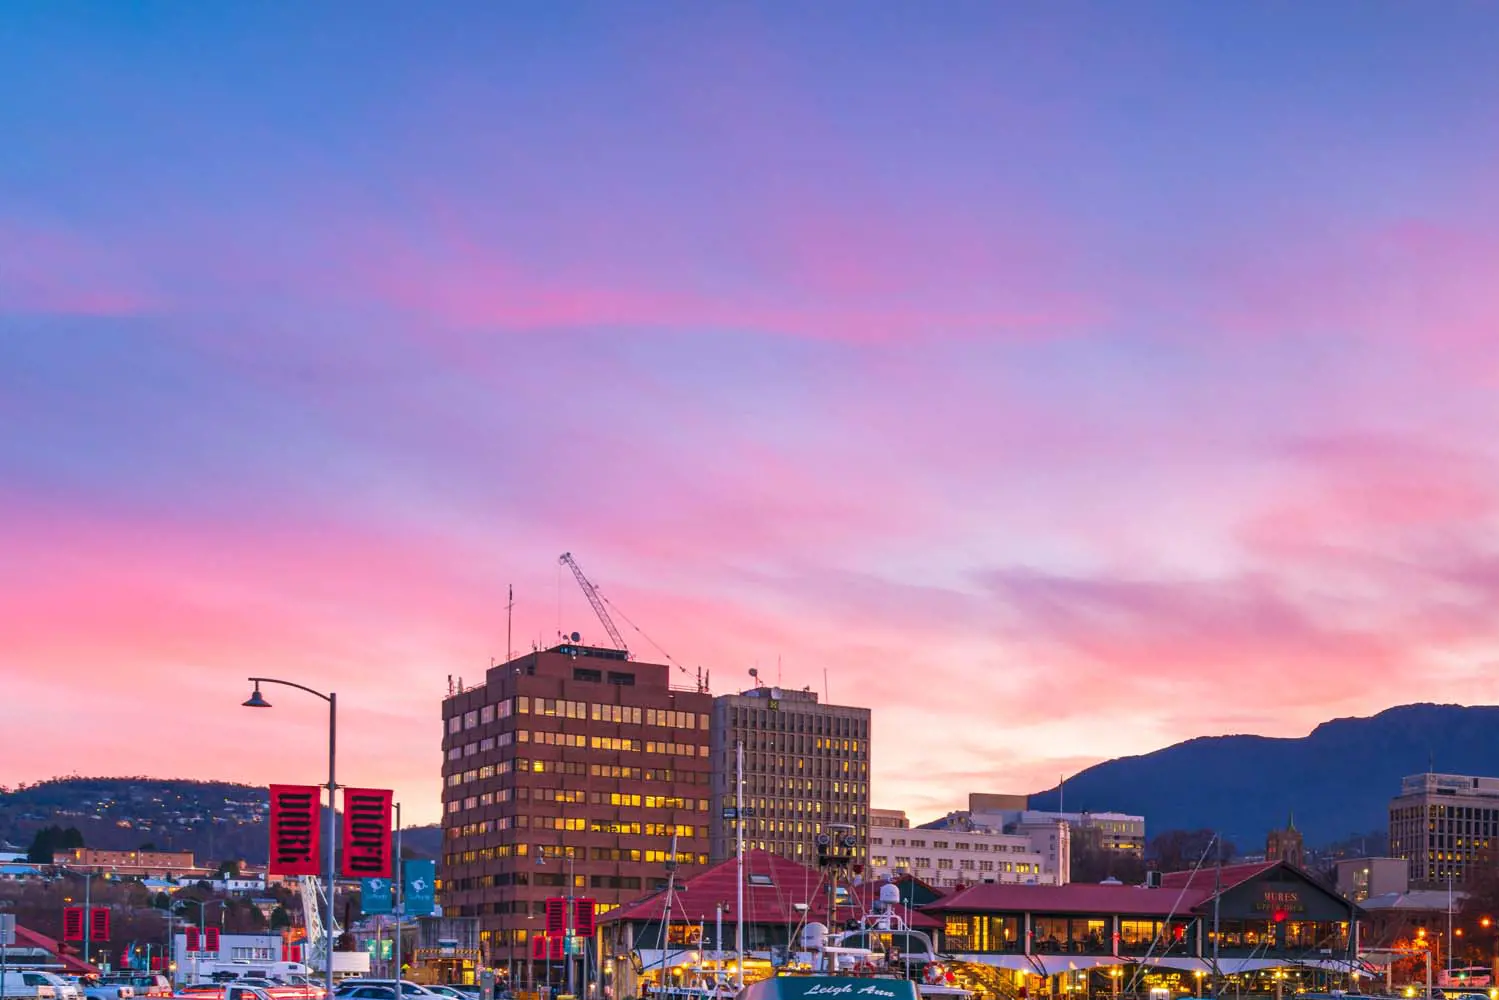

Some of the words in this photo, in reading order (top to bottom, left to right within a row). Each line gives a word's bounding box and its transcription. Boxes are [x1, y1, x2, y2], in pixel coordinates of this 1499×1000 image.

[1264, 892, 1298, 902] MURES
[803, 984, 853, 996] Leigh
[857, 985, 896, 997] Ann
